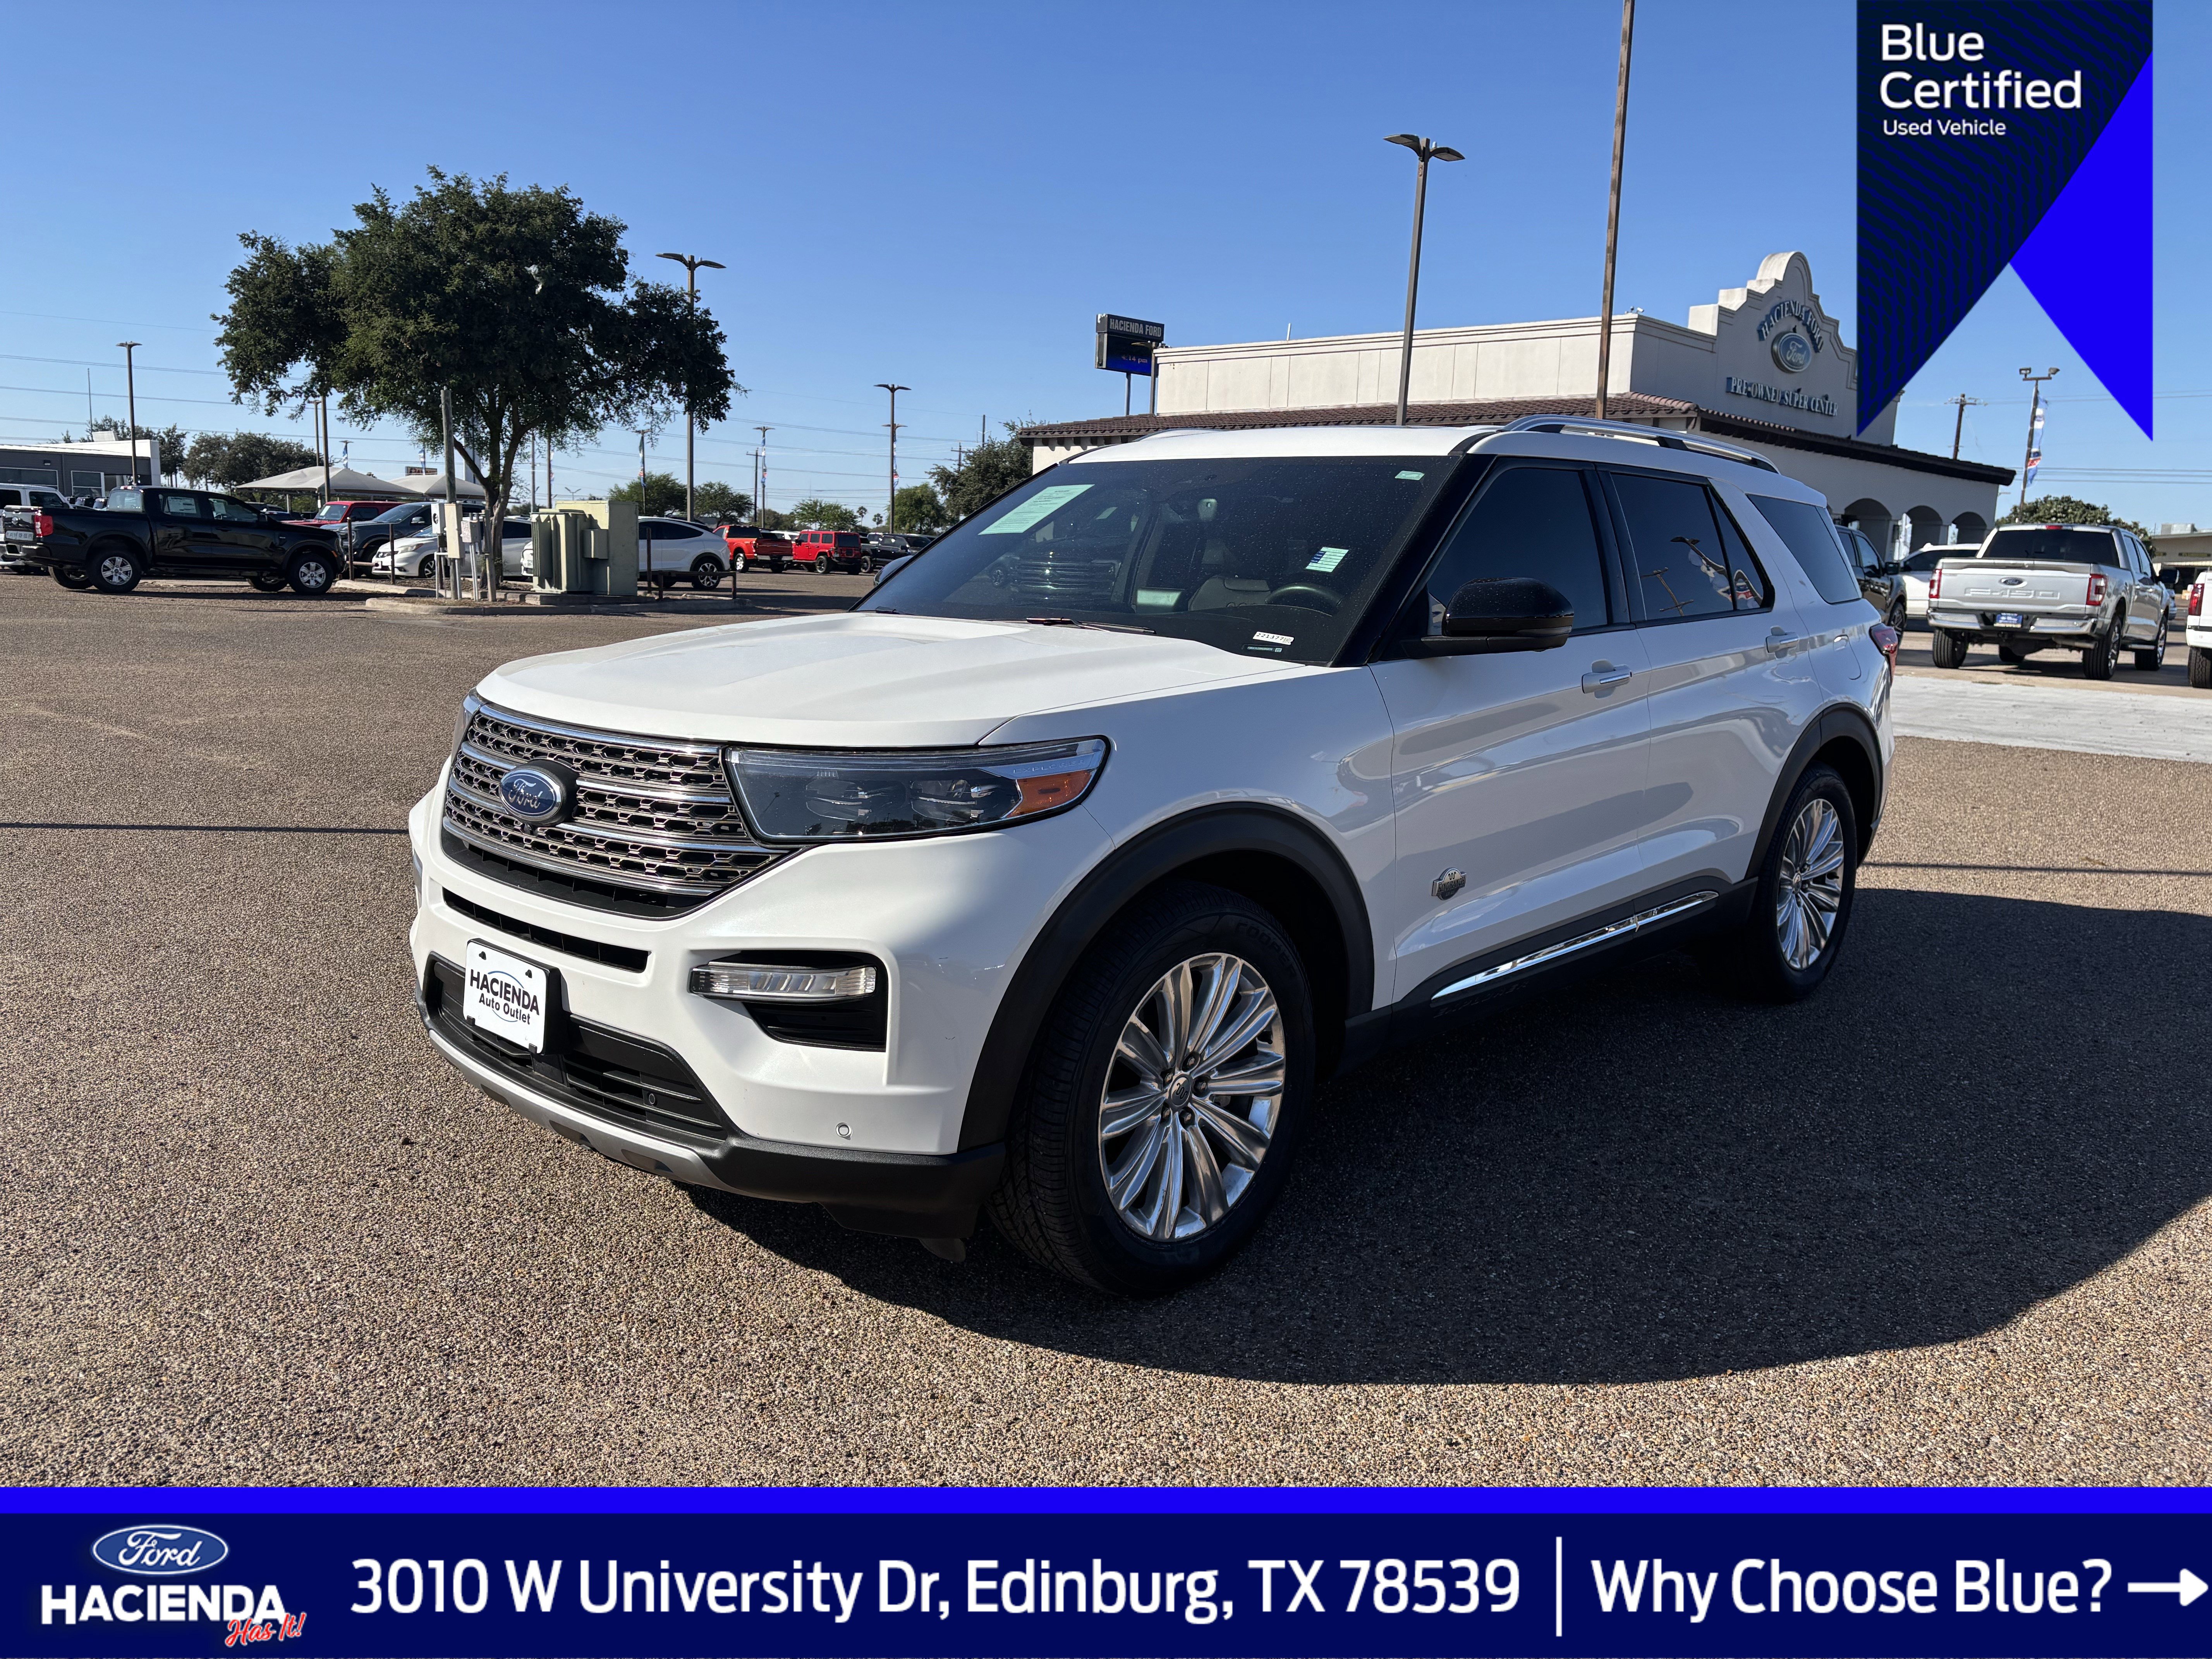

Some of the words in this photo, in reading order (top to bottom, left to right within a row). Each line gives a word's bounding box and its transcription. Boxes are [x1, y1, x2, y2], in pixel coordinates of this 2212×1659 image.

[1109, 318, 1144, 335] HACIENDA
[1145, 325, 1162, 337] FORD
[1761, 300, 1808, 340] HACIENDA
[1806, 311, 1824, 353] FORD
[1786, 341, 1807, 365] Ford
[1731, 377, 1782, 403] PRE-OWNED
[1783, 390, 1808, 410] SUPER
[1810, 397, 1838, 416] CENTER
[1964, 587, 2060, 600] F-150
[1013, 760, 1085, 774] EXPLORER
[508, 778, 543, 809] Ford
[1438, 882, 1449, 892] KING
[470, 969, 539, 1015] HACIENDA
[479, 993, 500, 1011] Auto
[503, 1003, 531, 1025] Outlet
